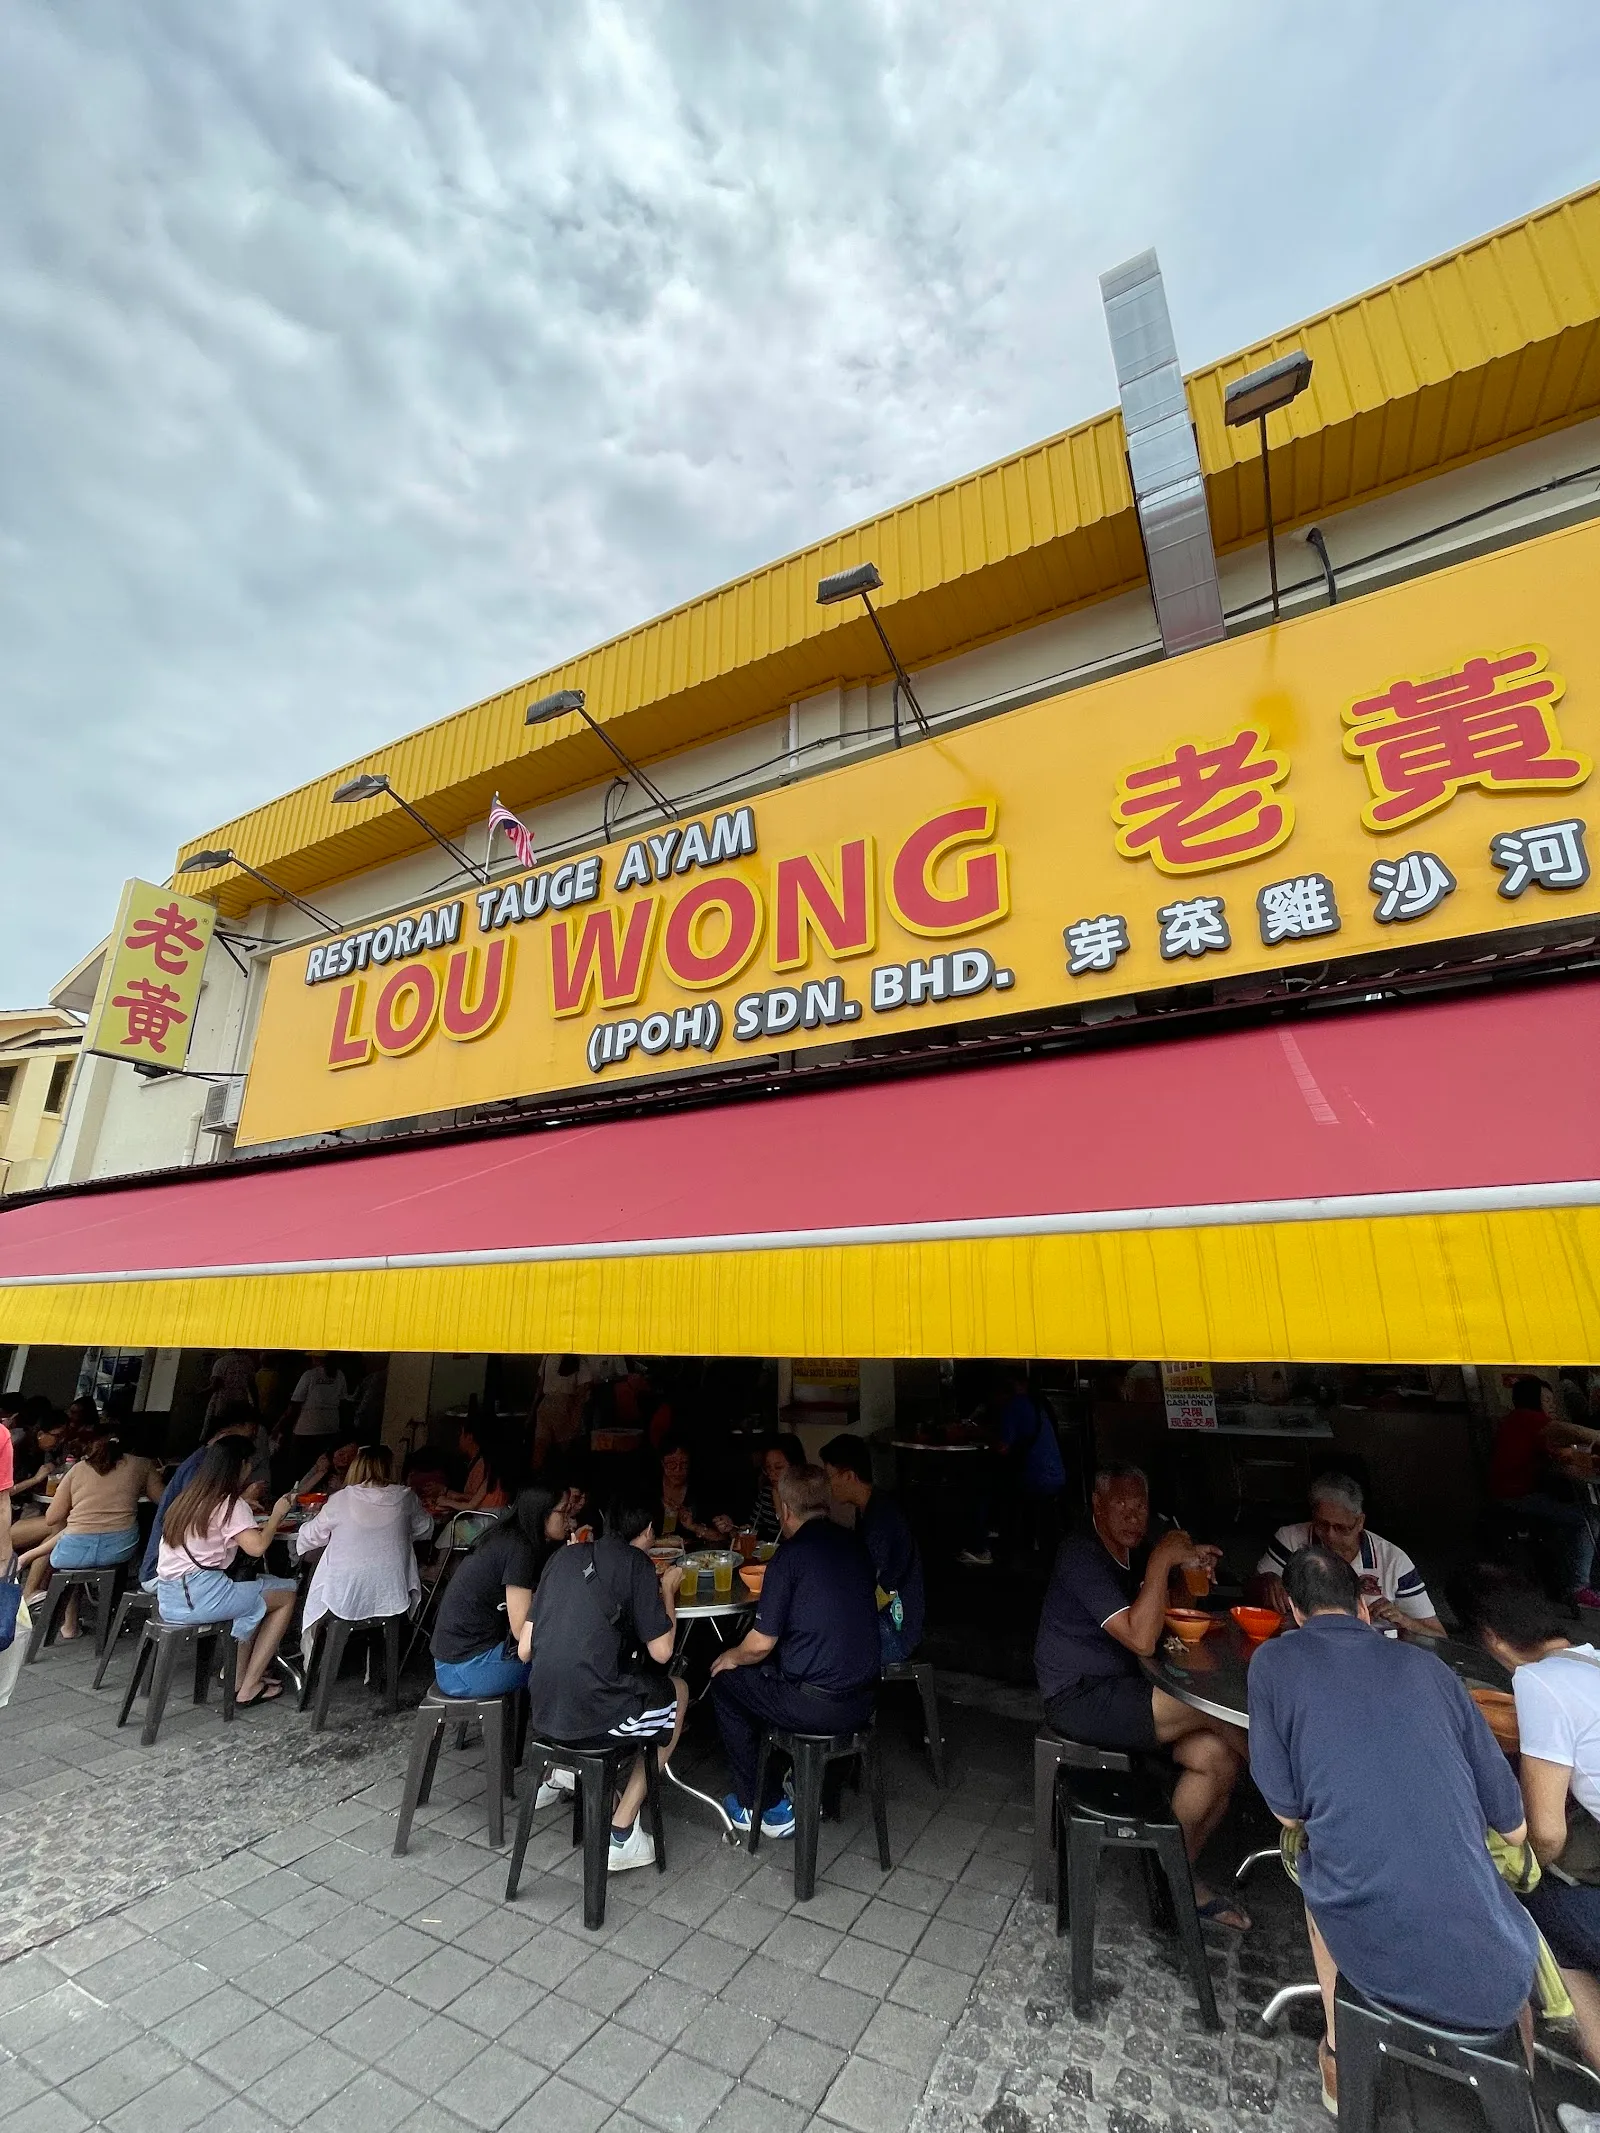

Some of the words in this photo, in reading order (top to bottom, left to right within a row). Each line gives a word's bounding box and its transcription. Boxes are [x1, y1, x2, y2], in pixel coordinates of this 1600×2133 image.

[1116, 647, 1587, 870] 老黃
[305, 902, 462, 985] RESTORAN
[478, 856, 601, 931] TAUGE
[615, 806, 756, 891] AYAM
[327, 937, 510, 1068] LOU
[549, 802, 1006, 1016] WONG
[1064, 818, 1590, 975] 芽菜雞沙河
[587, 1000, 721, 1071] (IPOH)
[734, 976, 861, 1040] SDN.
[872, 948, 1014, 1010] BHD.
[1170, 1417, 1216, 1428] 现金交易
[1181, 1407, 1203, 1417] 只限
